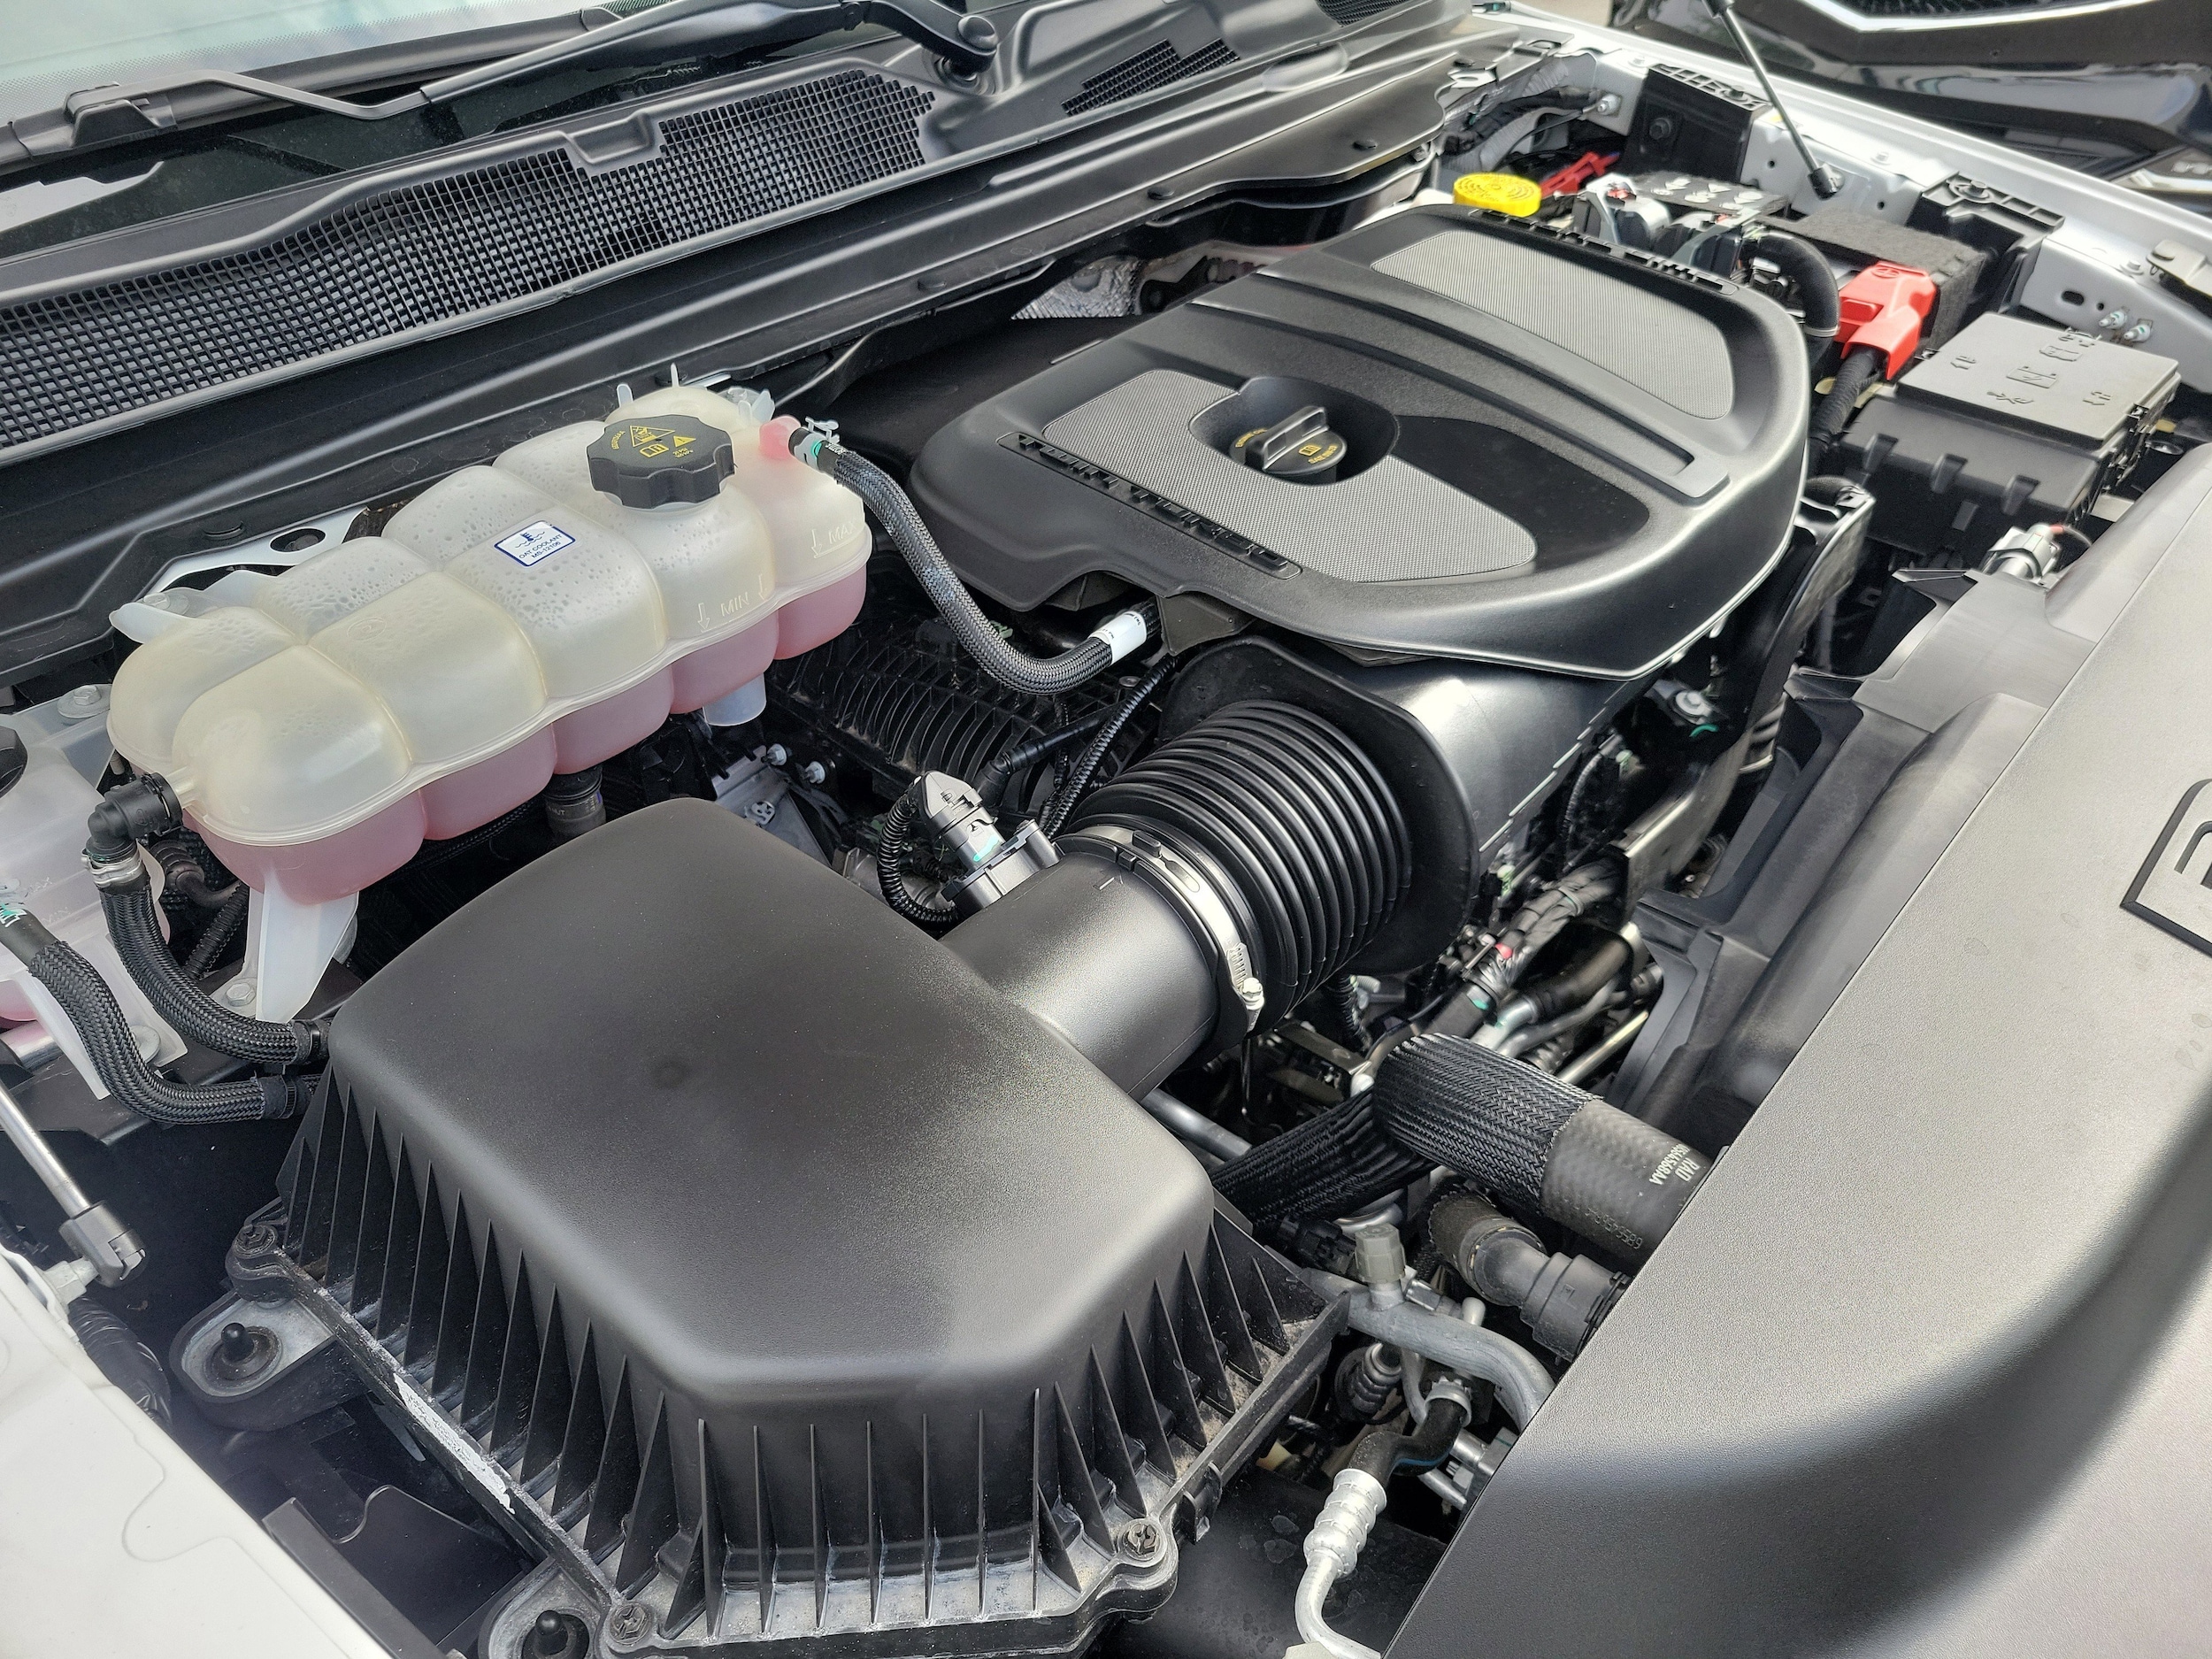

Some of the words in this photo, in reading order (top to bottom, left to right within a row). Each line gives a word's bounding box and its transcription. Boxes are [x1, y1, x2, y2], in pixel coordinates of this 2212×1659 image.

[828, 521, 857, 545] MAX
[518, 549, 533, 559] OAT
[533, 534, 563, 551] COOLANT
[720, 591, 750, 617] MIN
[1675, 1157, 1700, 1182] RAD
